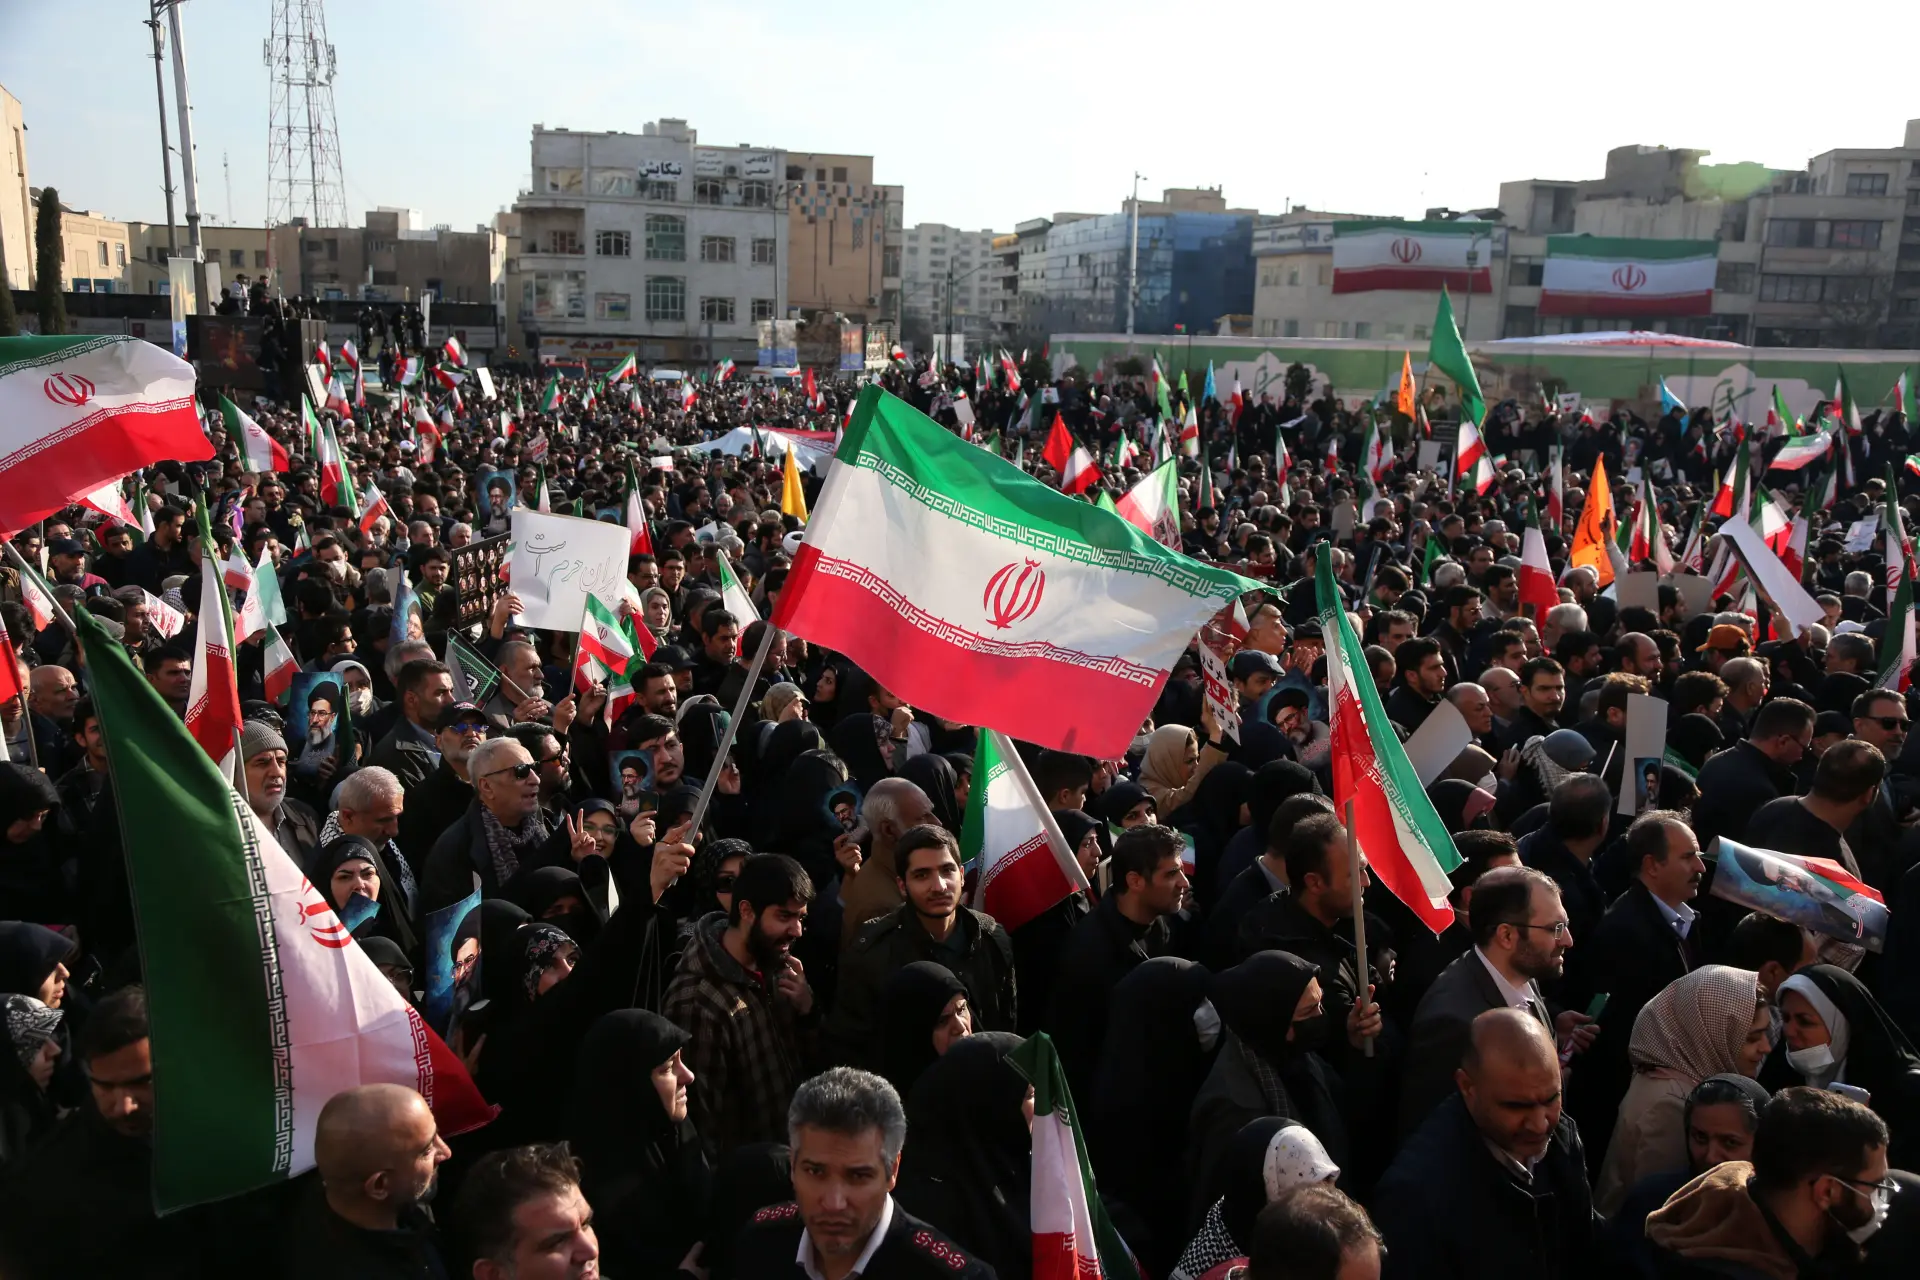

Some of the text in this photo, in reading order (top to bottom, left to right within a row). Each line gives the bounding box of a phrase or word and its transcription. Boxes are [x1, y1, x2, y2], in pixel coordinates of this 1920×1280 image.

[524, 533, 623, 605] ایران حرم است
